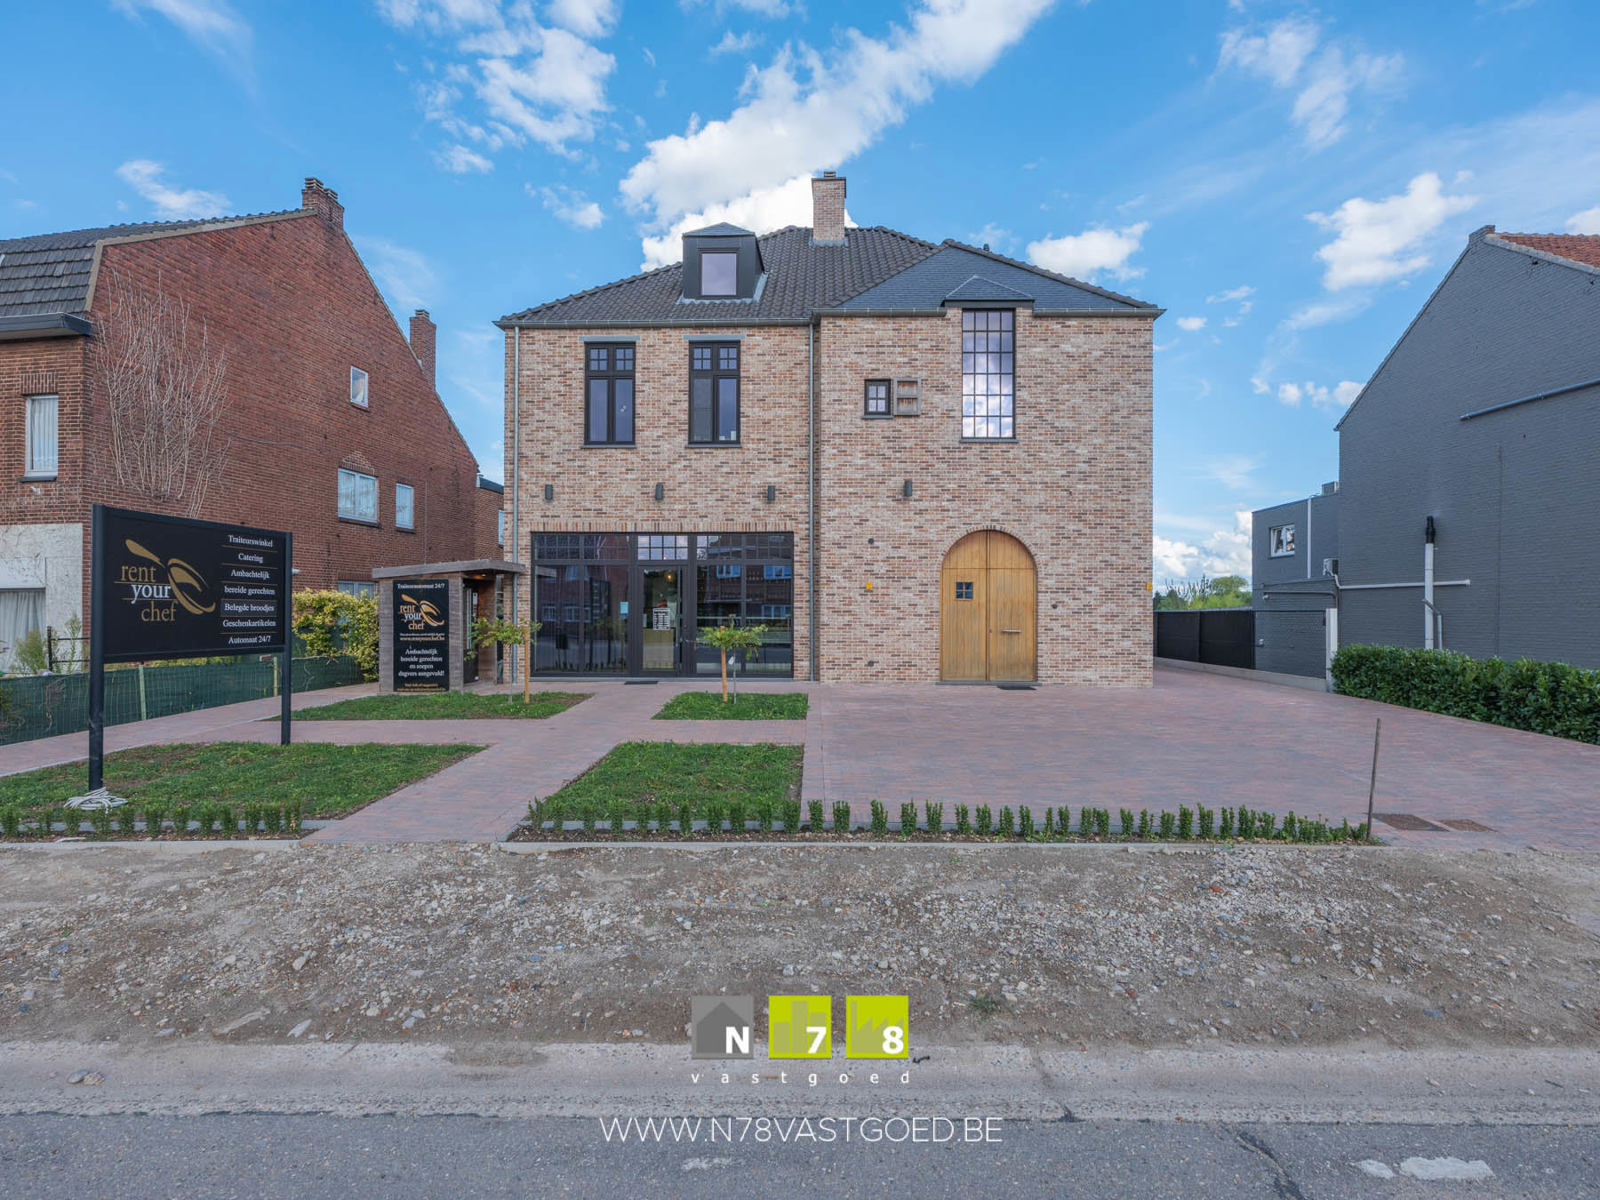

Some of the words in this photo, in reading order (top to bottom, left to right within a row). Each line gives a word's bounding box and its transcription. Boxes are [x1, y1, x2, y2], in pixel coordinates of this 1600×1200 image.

[238, 553, 264, 564] Catering
[121, 565, 157, 583] rent
[230, 569, 270, 580] Ambachtelijk
[131, 584, 172, 605] your
[224, 585, 247, 594] bereide
[247, 586, 275, 596] gerechten
[141, 599, 179, 622] chef
[224, 603, 249, 613] Belegde
[250, 603, 274, 613] broodjes
[399, 604, 416, 613] rent
[404, 613, 422, 623] your
[408, 620, 425, 630] chef
[258, 635, 271, 643] 24/7
